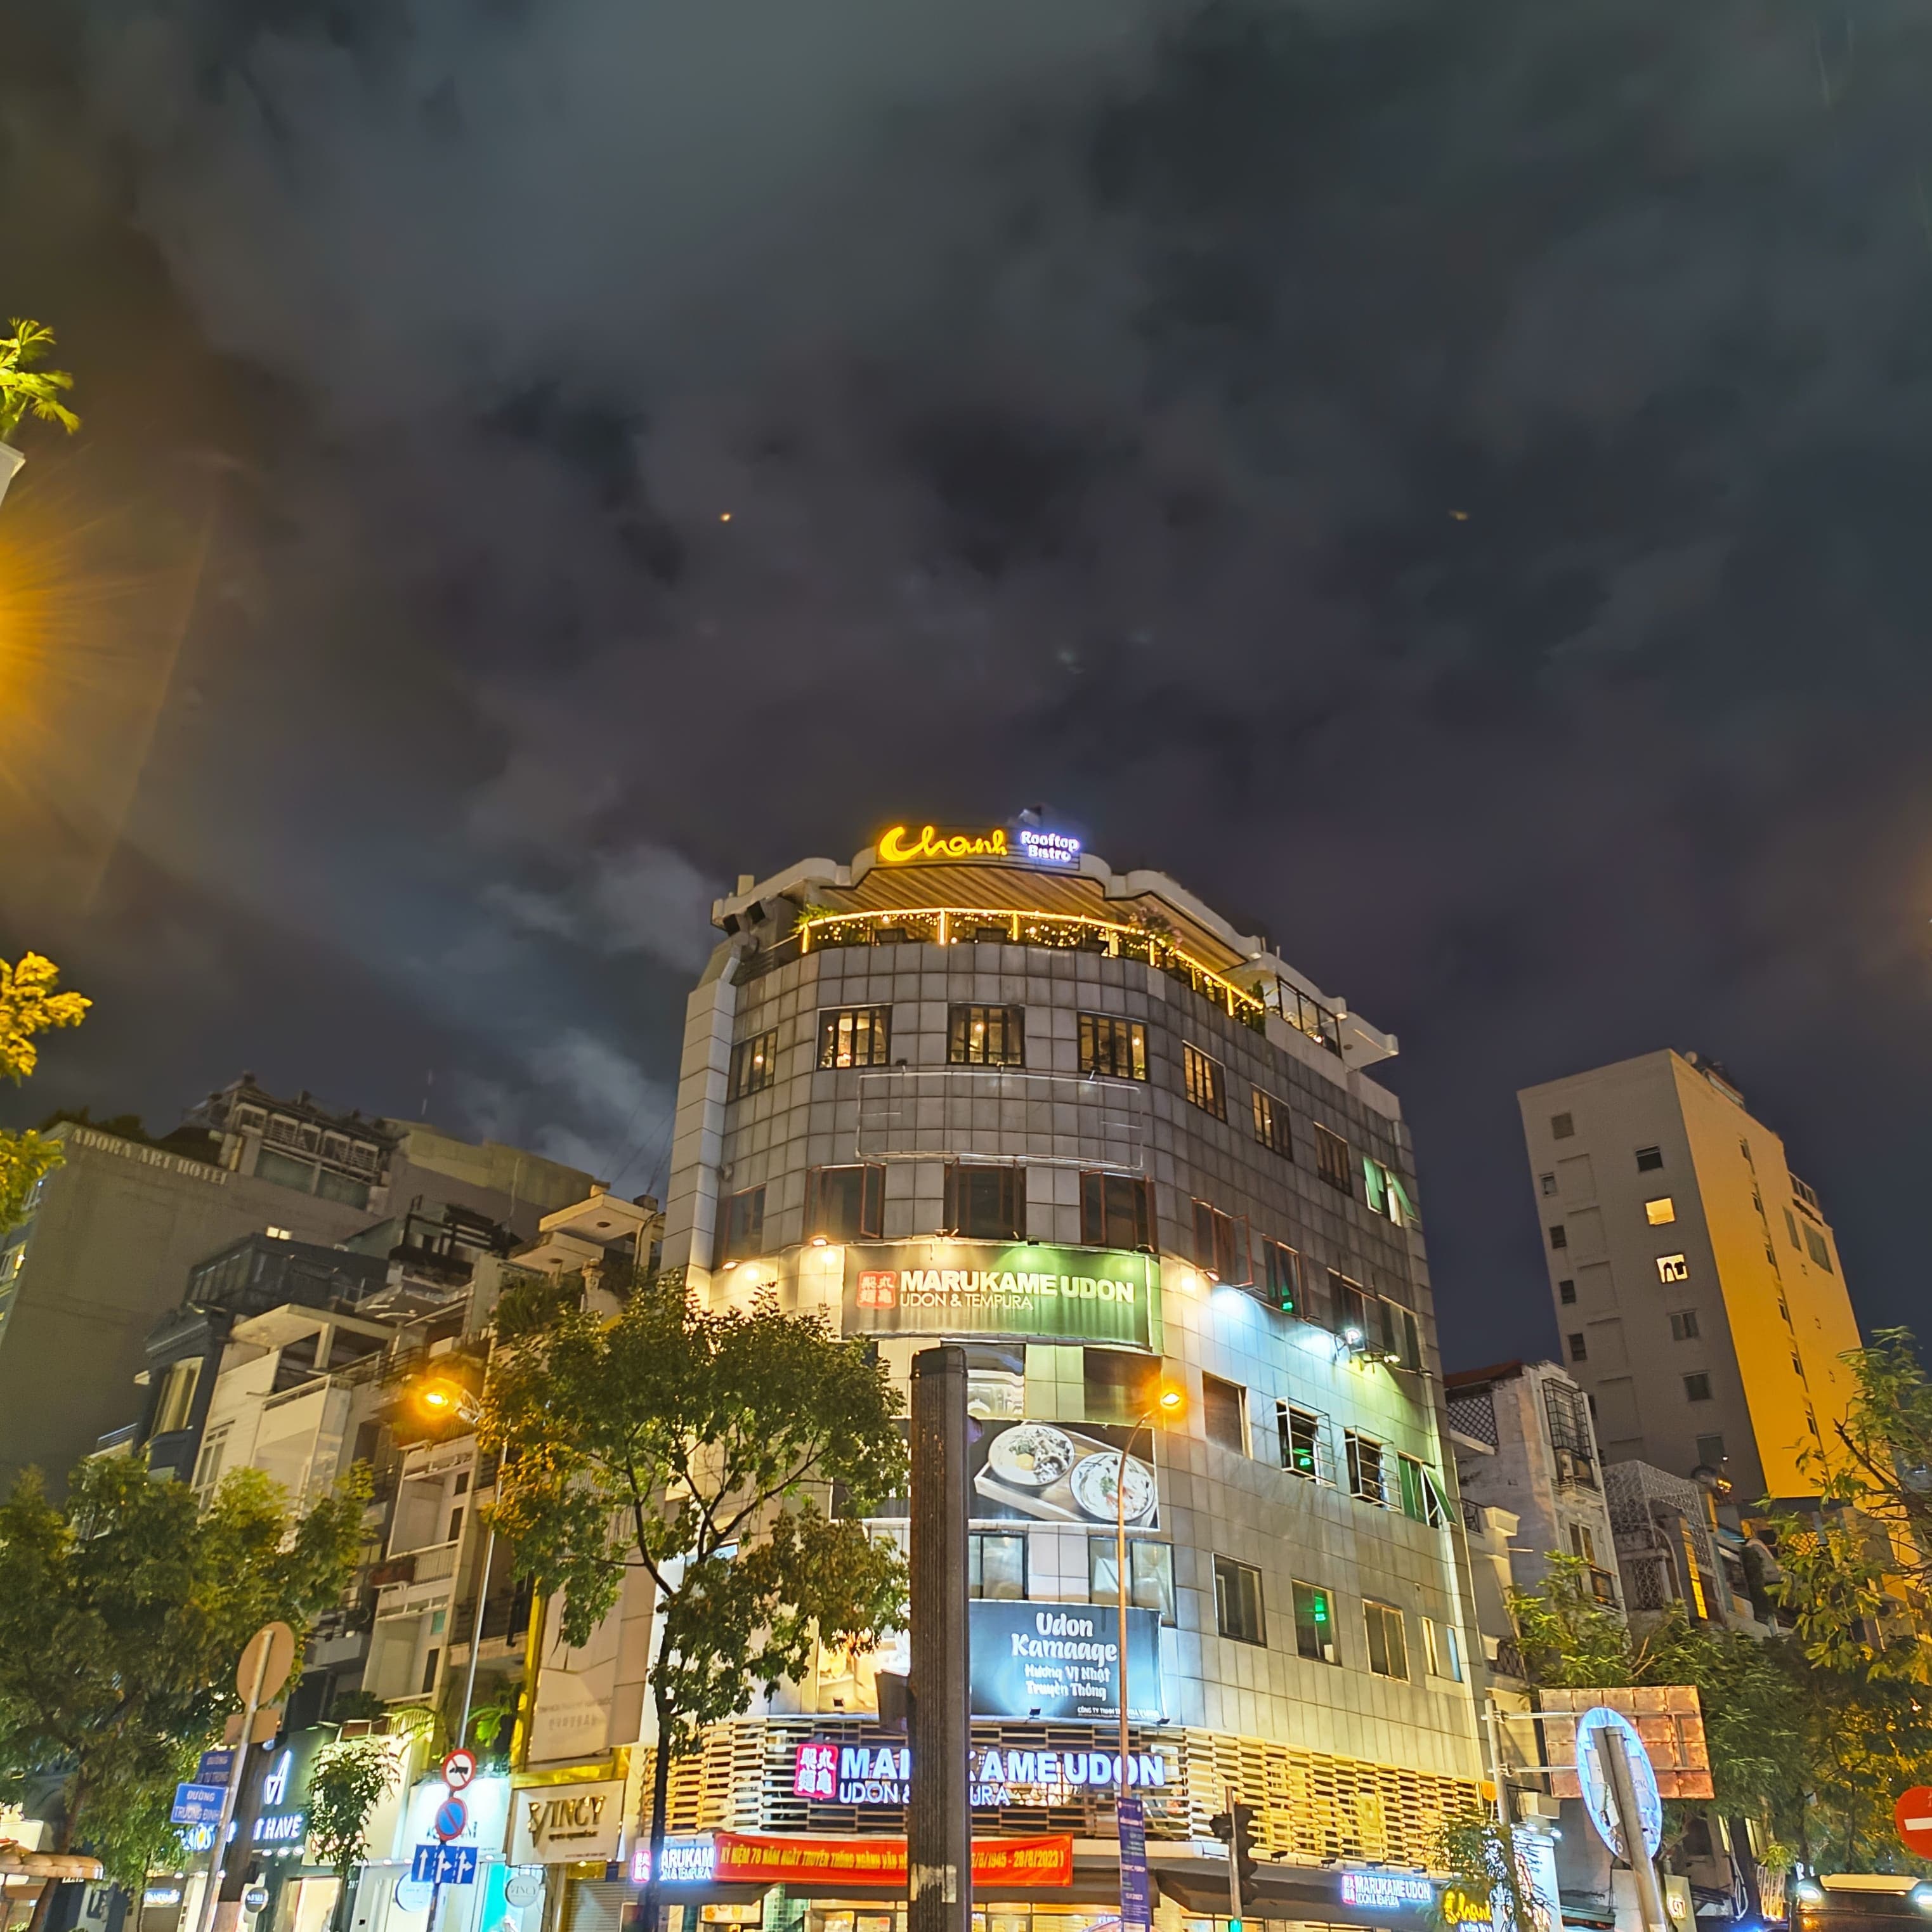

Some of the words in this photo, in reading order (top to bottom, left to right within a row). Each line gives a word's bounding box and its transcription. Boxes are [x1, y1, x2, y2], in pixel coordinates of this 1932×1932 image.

[879, 825, 1008, 862] Chanh
[1020, 830, 1080, 851] Rooftop
[1028, 844, 1071, 863] Bistro
[71, 1128, 131, 1158] ADORA
[137, 1147, 171, 1170] ART
[176, 1158, 228, 1185] HOTEL
[900, 1270, 1058, 1297] MARUKAME
[1060, 1276, 1135, 1304] UDON
[899, 1293, 948, 1309] UDON
[951, 1293, 963, 1308] &
[965, 1293, 1035, 1311] TEMPURA
[1036, 1612, 1093, 1638] Udon
[1010, 1633, 1118, 1668] Kamaage
[840, 1747, 1059, 1783] MAAME
[1063, 1752, 1166, 1787] UDON
[186, 1789, 216, 1802] ĐƯỜNG
[839, 1781, 899, 1804] UDON
[263, 1815, 304, 1839] HAVE
[527, 1795, 607, 1848] VINCY
[660, 1846, 715, 1868] ARUKAM
[750, 1848, 762, 1864] 78
[510, 1884, 537, 1897] VINCY
[1354, 1874, 1406, 1898] MARUKAME
[1406, 1880, 1432, 1900] UDON
